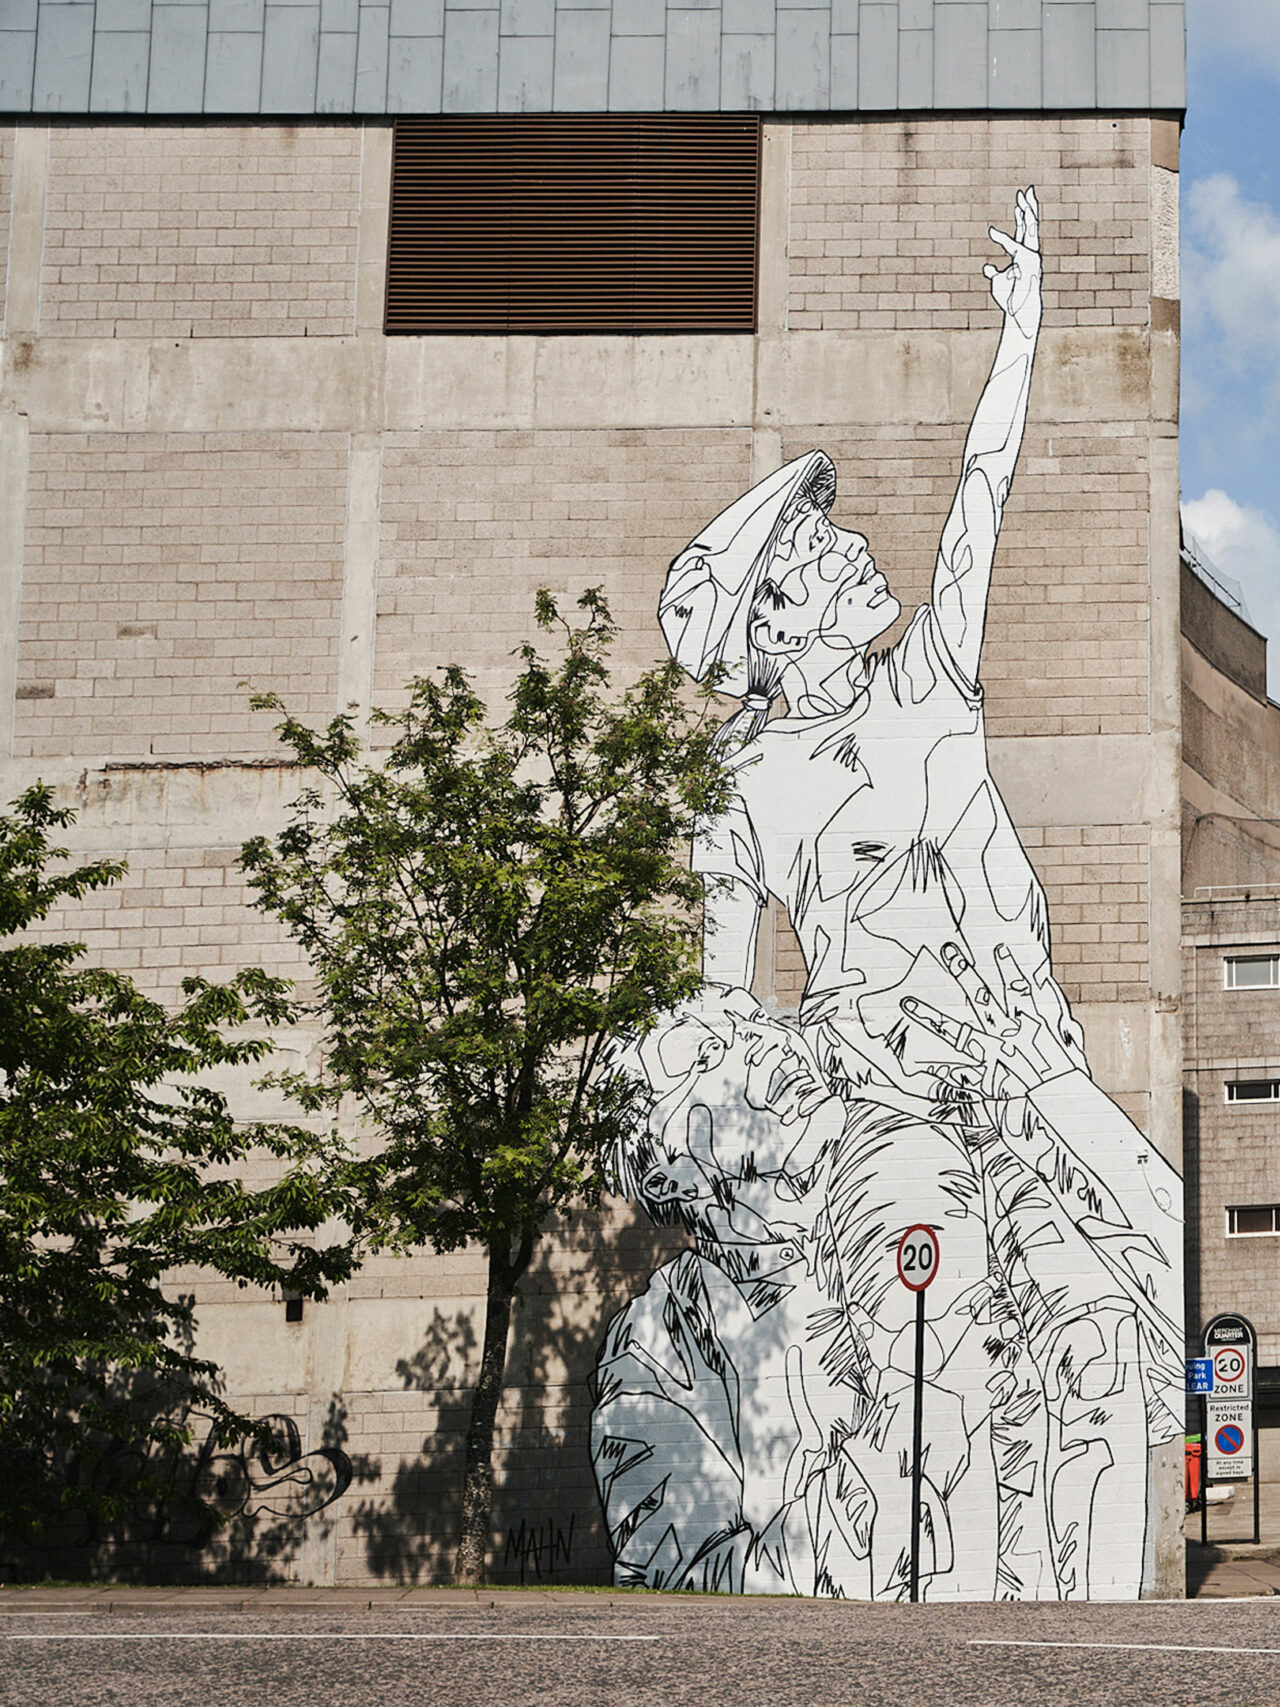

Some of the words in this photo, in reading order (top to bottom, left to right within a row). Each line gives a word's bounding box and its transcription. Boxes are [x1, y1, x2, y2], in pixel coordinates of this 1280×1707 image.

[903, 1243, 933, 1271] 20
[1218, 1358, 1241, 1372] 20
[1189, 1371, 1207, 1380] Park
[1186, 1381, 1208, 1390] LEAR
[1214, 1384, 1244, 1394] ZONE
[1210, 1404, 1249, 1412] Restricted
[1215, 1413, 1244, 1422] ZONE
[504, 1512, 575, 1585] MAHN
